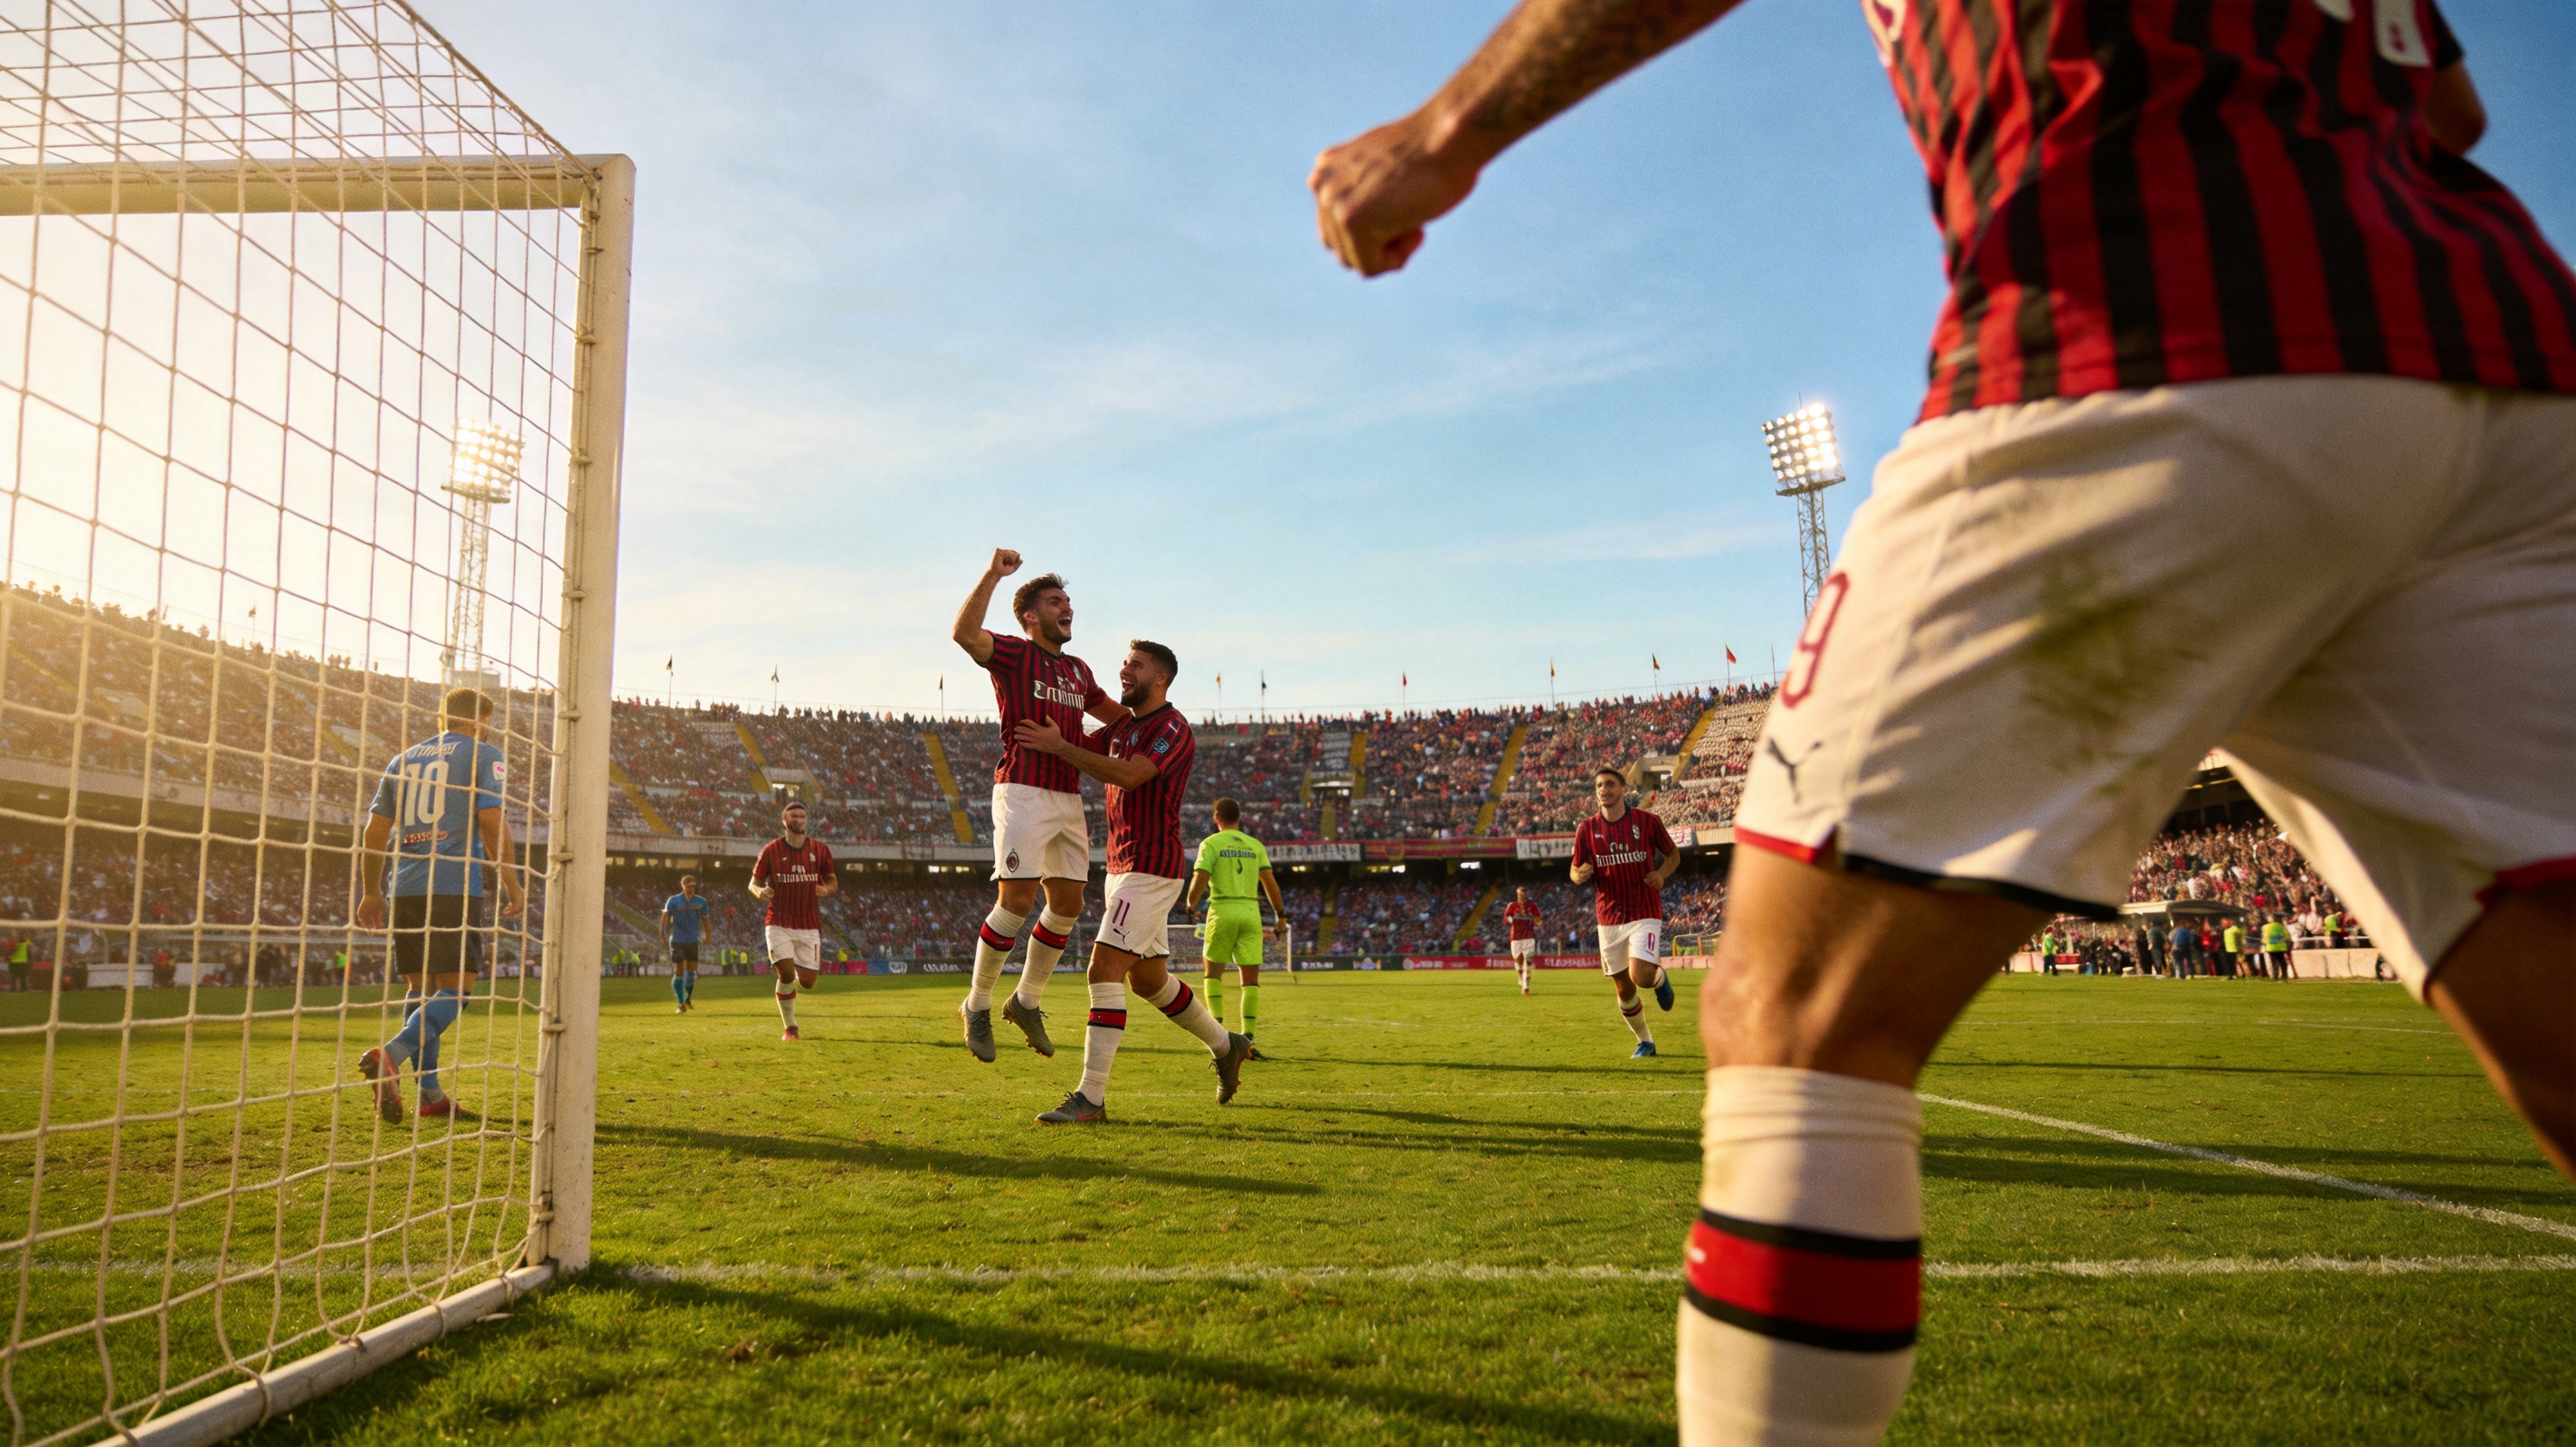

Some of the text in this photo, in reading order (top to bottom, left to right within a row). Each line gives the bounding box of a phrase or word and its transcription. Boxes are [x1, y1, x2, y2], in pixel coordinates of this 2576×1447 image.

[1781, 572, 1851, 710] 9
[404, 761, 450, 827] 10
[1112, 898, 1131, 927] 11
